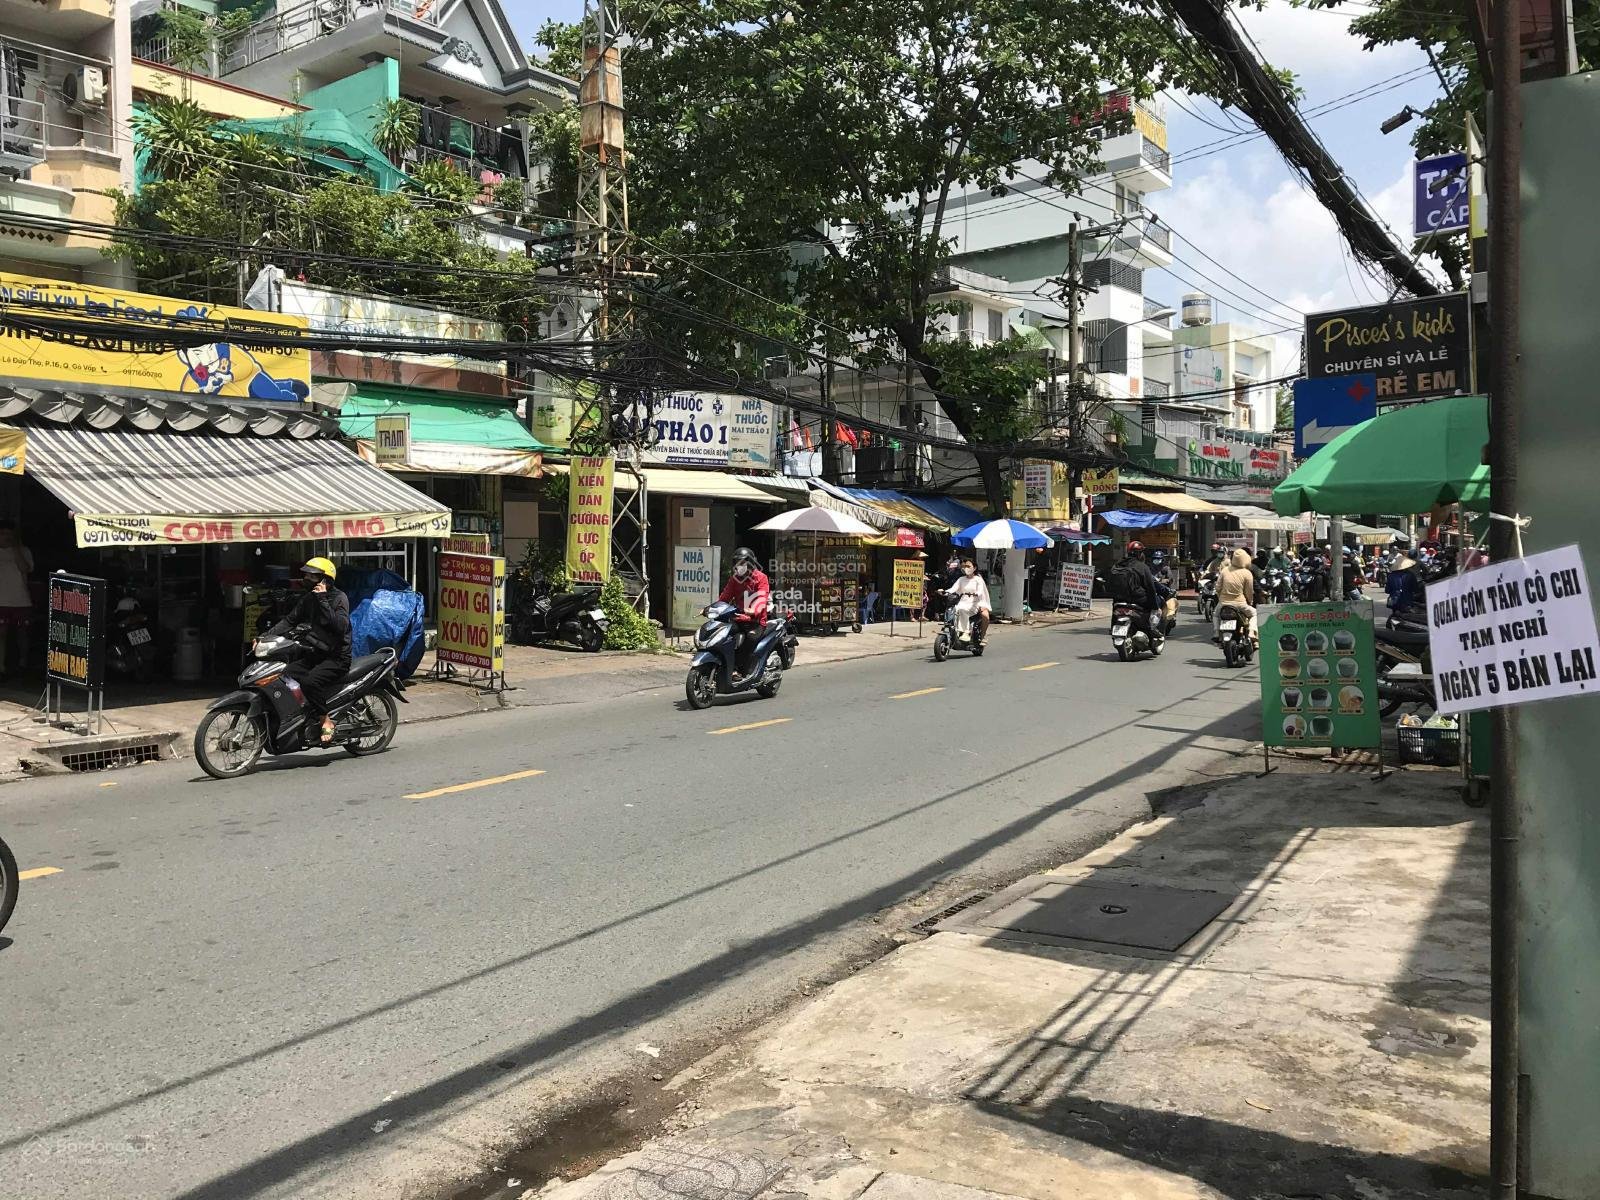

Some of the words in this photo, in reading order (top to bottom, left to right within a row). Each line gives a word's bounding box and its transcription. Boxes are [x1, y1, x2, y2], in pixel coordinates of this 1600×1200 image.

[1315, 314, 1406, 353] Pisces's
[1412, 306, 1456, 343] kids
[1324, 356, 1384, 375] CHUYÊN
[1404, 349, 1426, 364] VÀ
[1429, 345, 1449, 362] LẺ
[1417, 369, 1456, 392] EM
[667, 391, 703, 412] THUỐC
[735, 411, 768, 425] THUỐC
[656, 413, 714, 444] THẢO
[718, 425, 728, 445] 1
[746, 426, 765, 435] THẢO
[577, 473, 605, 489] KIỆN
[570, 511, 609, 526] CƯỜNG
[83, 530, 110, 543] 0971
[111, 530, 134, 542] 600
[577, 532, 600, 546] LỰC
[580, 547, 596, 564] ỐP
[683, 549, 704, 564] NHÀ
[676, 565, 711, 583] THUỐC
[688, 584, 706, 594] THẢO
[1433, 592, 1460, 629] QUÁN
[1461, 587, 1487, 619] CƠM
[1487, 573, 1522, 612] TẤM
[1524, 569, 1548, 604] CÔ
[1550, 567, 1582, 599] CHI
[1459, 626, 1496, 654] TẠM
[1498, 609, 1549, 643] NGHỈ
[1439, 660, 1482, 702] NGÀY
[1484, 662, 1501, 694] 5
[1502, 648, 1551, 692] BÁN
[1554, 646, 1597, 690] LẠI
